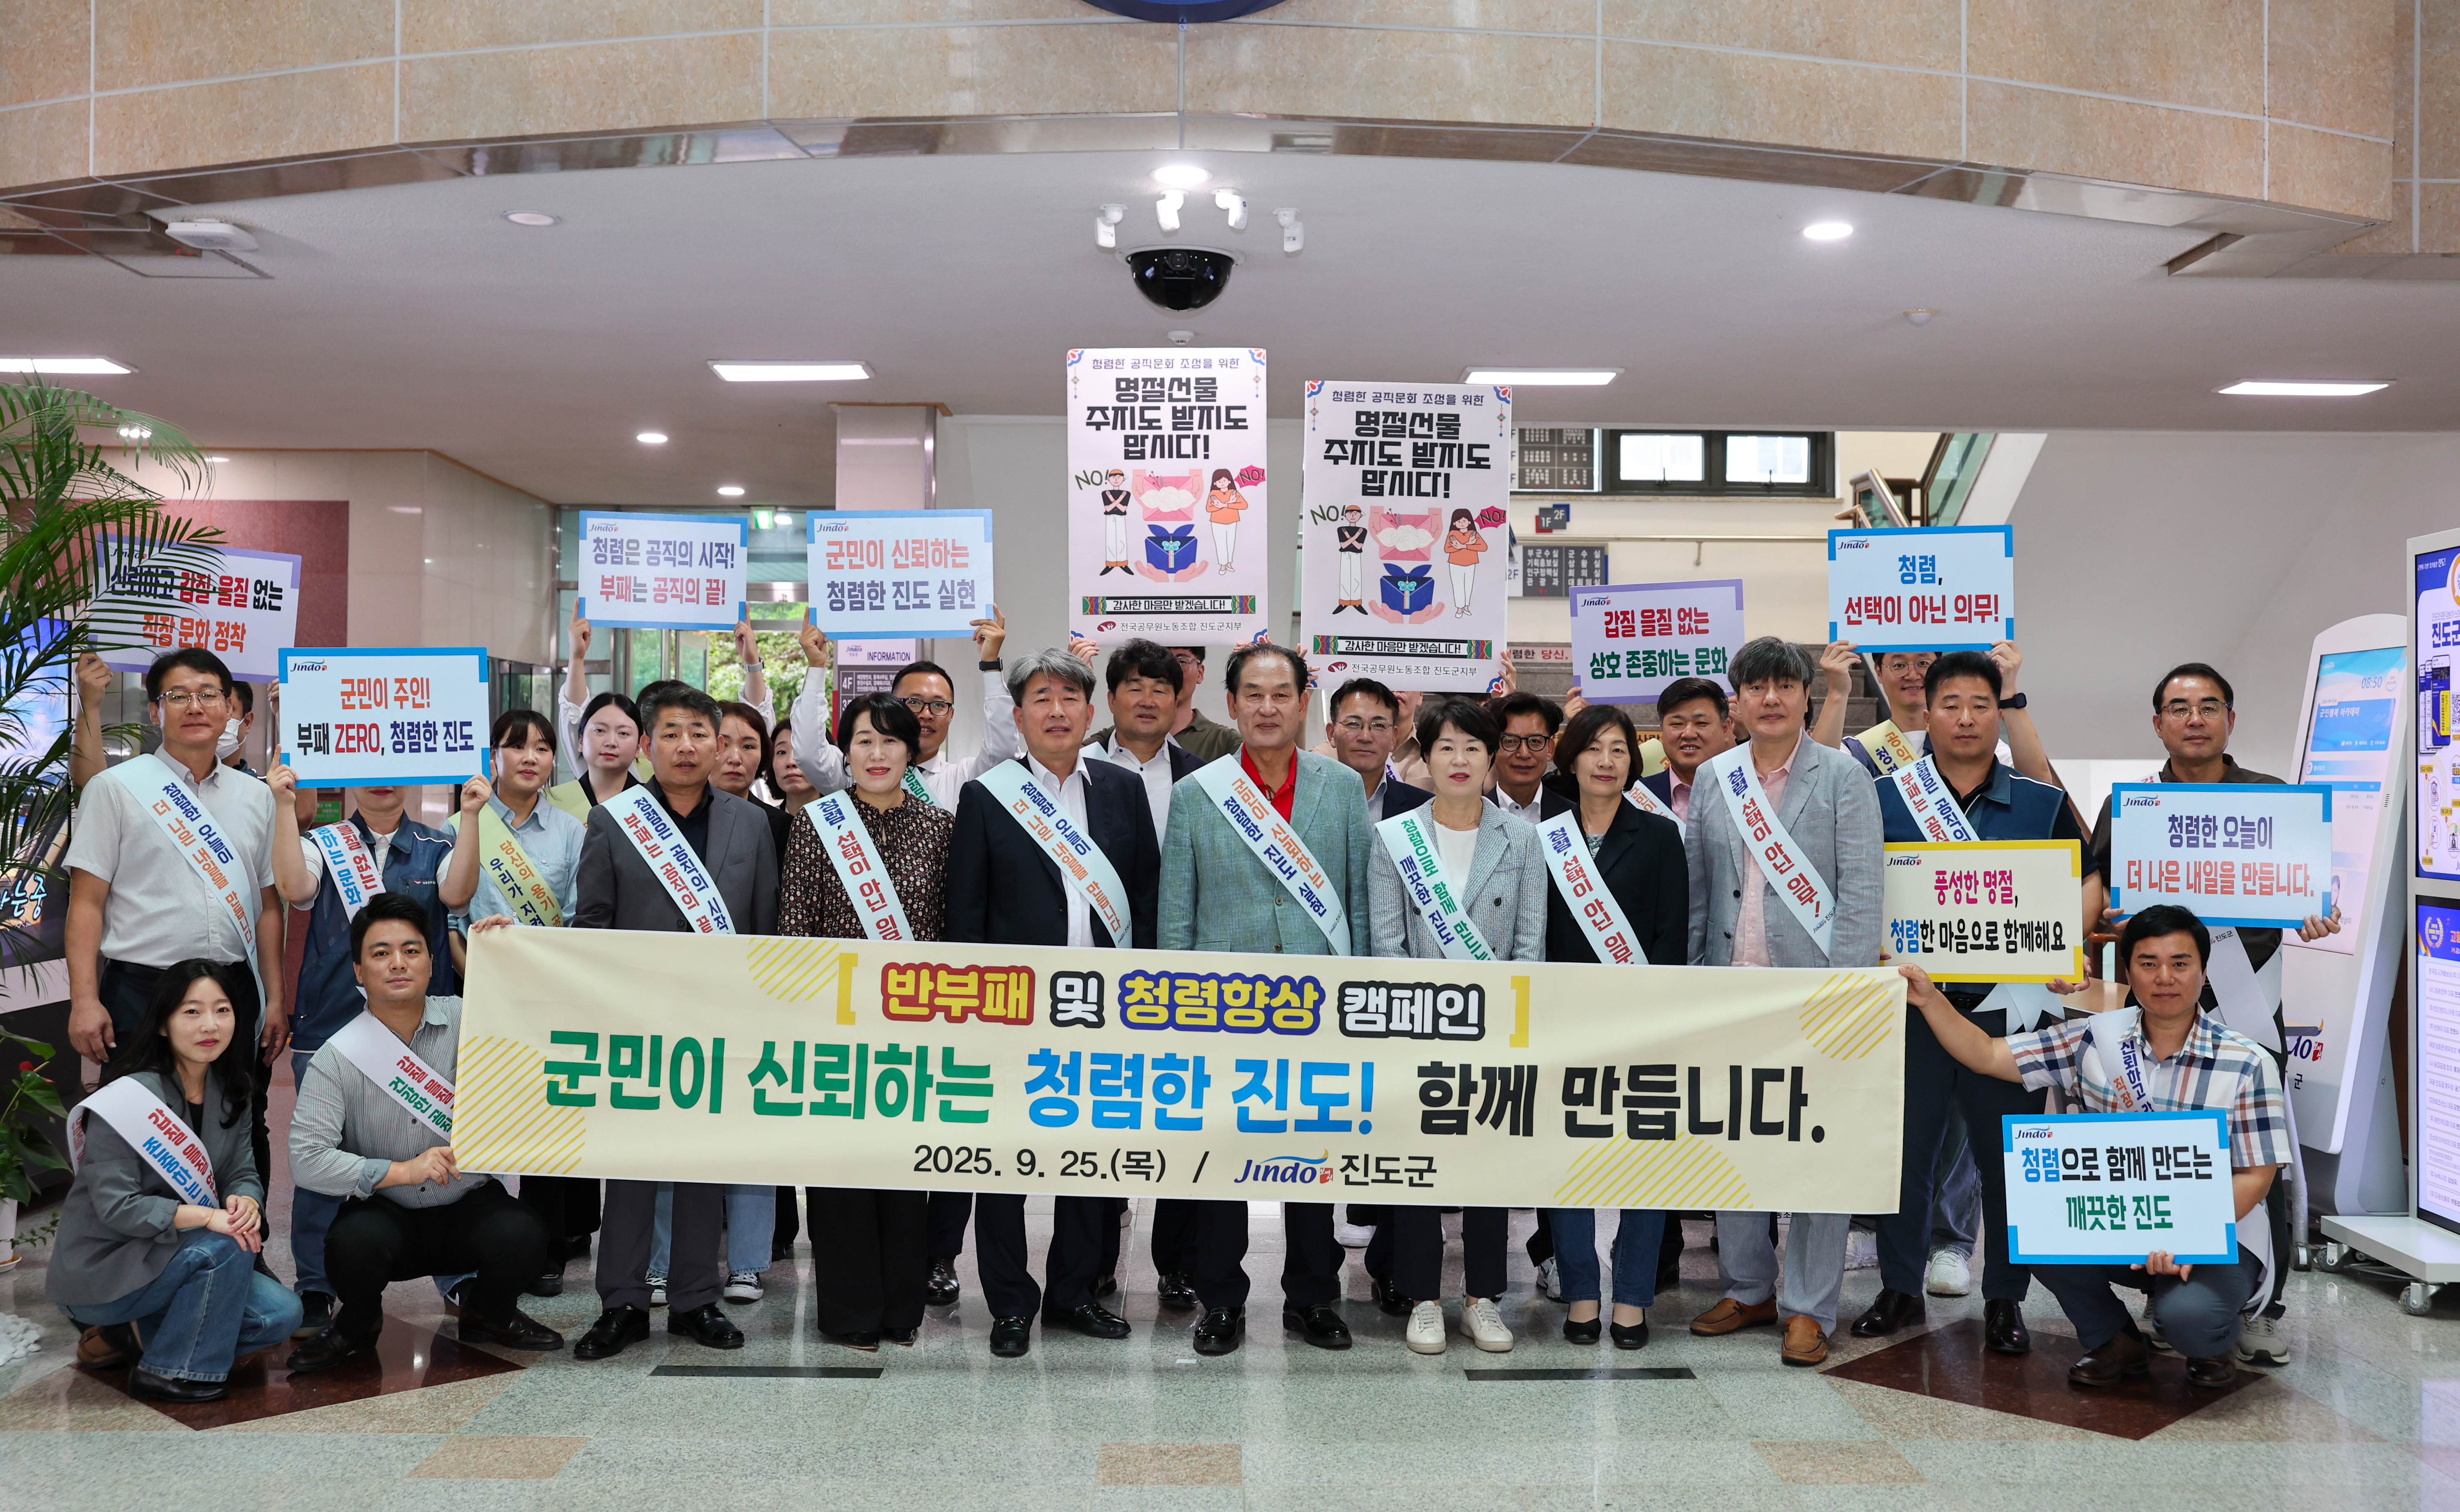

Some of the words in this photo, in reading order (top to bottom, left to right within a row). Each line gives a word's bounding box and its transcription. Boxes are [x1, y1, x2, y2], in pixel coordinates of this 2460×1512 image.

[1092, 359, 1125, 369] 청렴한
[1131, 358, 1174, 369] 공직문화
[1180, 358, 1213, 369] 조성을
[1218, 358, 1240, 369] 위한
[1115, 377, 1218, 403] 명절선물
[1332, 390, 1367, 402] 청렴한
[1372, 392, 1417, 404] 공직문화
[1423, 393, 1457, 405] 조성을
[1462, 394, 1485, 406] 위한
[1086, 405, 1162, 431] 주지도
[1172, 405, 1248, 431] 받지도
[1355, 411, 1461, 440] 명절선물
[1123, 434, 1210, 460] 맙시다!
[1323, 439, 1403, 467] 주지도
[1412, 442, 1491, 469] 받지도
[1075, 469, 1109, 490] NO!
[1239, 469, 1264, 483] NO!
[1362, 470, 1450, 498] 맙시다!
[589, 524, 613, 532] Jindo
[817, 524, 843, 533] Jindo
[1310, 505, 1346, 525] NO!
[1480, 511, 1506, 526] NO!
[1541, 517, 1551, 527] 1F
[1553, 510, 1565, 520] 2F
[592, 537, 640, 565] 청렴은
[646, 540, 693, 567] 공직의
[699, 542, 735, 569] 시작!
[826, 539, 884, 570] 군민이
[891, 537, 969, 569] 신뢰하는
[1838, 541, 1864, 550] Jindo
[1508, 569, 1519, 580] 2F
[1898, 555, 1943, 585] 청렴,
[111, 564, 175, 599] 신뢰하고
[253, 579, 283, 611] 없는
[600, 575, 647, 603] 부패는
[653, 577, 699, 604] 공직의
[706, 578, 726, 605] 끝!
[827, 580, 886, 611] 청렴한
[892, 581, 931, 610] 진도
[937, 579, 976, 610] 실현
[1581, 598, 1605, 607] Jindo
[1113, 600, 1142, 611] 감사한
[1144, 600, 1173, 611] 마음만
[1175, 600, 1225, 610] 받겠습니다!
[1845, 596, 1901, 625] 선택이
[1909, 594, 1946, 624] 아닌
[1954, 594, 1998, 623] 의무!
[142, 614, 175, 647] 직장
[179, 617, 211, 649] 문화
[214, 621, 246, 653] 정착
[1120, 622, 1197, 632] 전국공무원노동조합
[1200, 622, 1242, 631] 진도군지부
[1605, 610, 1636, 638] 갑질
[1640, 608, 1672, 637] 을질
[1678, 607, 1709, 635] 없는
[867, 652, 910, 661] INFORMATION
[1345, 641, 1375, 652] 감사한
[1377, 642, 1407, 653] 마음만
[1409, 642, 1461, 654] 받겠습니다!
[1510, 649, 1535, 659] 렴한
[1542, 650, 1568, 660] 당신,
[1590, 652, 1622, 679] 상호
[1626, 649, 1690, 677] 존중하는
[1695, 647, 1727, 675] 문화
[290, 661, 321, 672] Jindo
[1351, 663, 1431, 675] 전국공무원노동조합
[1434, 666, 1477, 676] 진도군지부
[340, 677, 388, 709] 군민이
[394, 677, 430, 709] 주인!
[842, 677, 852, 689] 4F
[2362, 677, 2382, 689] 08:50
[297, 723, 330, 756] 부패
[335, 723, 385, 756] ZERO,
[390, 720, 438, 753] 청렴한
[442, 721, 474, 752] 진도
[2123, 797, 2154, 806] Jindo
[1020, 781, 1057, 817] 청렴한
[1056, 819, 1091, 855] 오늘이
[1232, 778, 1270, 820] 군민이
[1271, 823, 1325, 889] 신뢰하는
[2168, 814, 2218, 848] 청렴한
[2223, 816, 2273, 849] 오늘이
[633, 797, 673, 840] 청렴은
[670, 844, 709, 892] 공직의
[1223, 796, 1264, 842] 청렴한
[1264, 844, 1297, 881] 진도
[1298, 882, 1327, 918] 실현
[1727, 765, 1748, 799] 청렴,
[1742, 797, 1772, 842] 선택이
[1765, 841, 1795, 875] 아닌
[1787, 872, 1820, 918] 의무!
[337, 825, 362, 851] 을질
[353, 854, 377, 890] 없는
[624, 813, 663, 858] 부패는
[660, 862, 700, 910] 공직의
[1013, 799, 1030, 815] 더
[1027, 815, 1054, 842] 나은
[1052, 841, 1089, 881] 내일을
[1086, 881, 1121, 933] 만듭니다
[1401, 819, 1439, 877] 청렴으로
[1432, 881, 1458, 916] 함께
[1887, 857, 1916, 866] Jindo
[337, 868, 362, 905] 문화
[490, 858, 524, 898] 우리가
[499, 840, 534, 880] 당신의
[531, 884, 555, 911] 용기
[1934, 870, 1979, 905] 풍성한
[1984, 870, 2018, 908] 명절,
[2127, 860, 2141, 892] 더
[2149, 860, 2180, 893] 나은
[2187, 861, 2235, 895] 내일을
[2241, 862, 2314, 897] 만듭니다.
[1400, 855, 1432, 905] 깨끗한
[1428, 910, 1455, 945] 진도
[1891, 918, 1934, 953] 청렴한
[1939, 919, 1999, 954] 마음으로
[2004, 919, 2066, 953] 함께해요
[2215, 930, 2233, 942] 진도군
[883, 963, 1033, 1023] 반부패
[1050, 970, 1104, 1028] 및
[1118, 969, 1325, 1035] 청렴향상
[1337, 980, 1485, 1041] 캠페인
[2121, 1040, 2146, 1100] 신뢰하고
[543, 1031, 725, 1114] 군민이
[747, 1039, 995, 1124] 신뢰하는
[1024, 1048, 1210, 1130] 청렴한
[1231, 1059, 1374, 1134] 진도!
[1417, 1061, 1538, 1137] 함께
[1561, 1063, 1826, 1143] 만듭니다.
[2114, 1075, 2133, 1108] 직장
[148, 1108, 188, 1146] 갑질
[182, 1143, 209, 1175] 을질
[2015, 1129, 2046, 1139] Jindo
[143, 1136, 202, 1200] 존중하는
[913, 1146, 1001, 1176] 2025.
[1016, 1148, 1045, 1178] 9.
[1060, 1150, 1166, 1182] 25.(목)
[1234, 1160, 1318, 1184] Jindo
[1339, 1154, 1436, 1188] 진도군
[2022, 1147, 2100, 1182] 청렴으로
[2106, 1146, 2146, 1182] 함께
[2152, 1145, 2212, 1180] 만드는
[2066, 1195, 2126, 1230] 깨끗한
[2132, 1195, 2173, 1230] 진도
